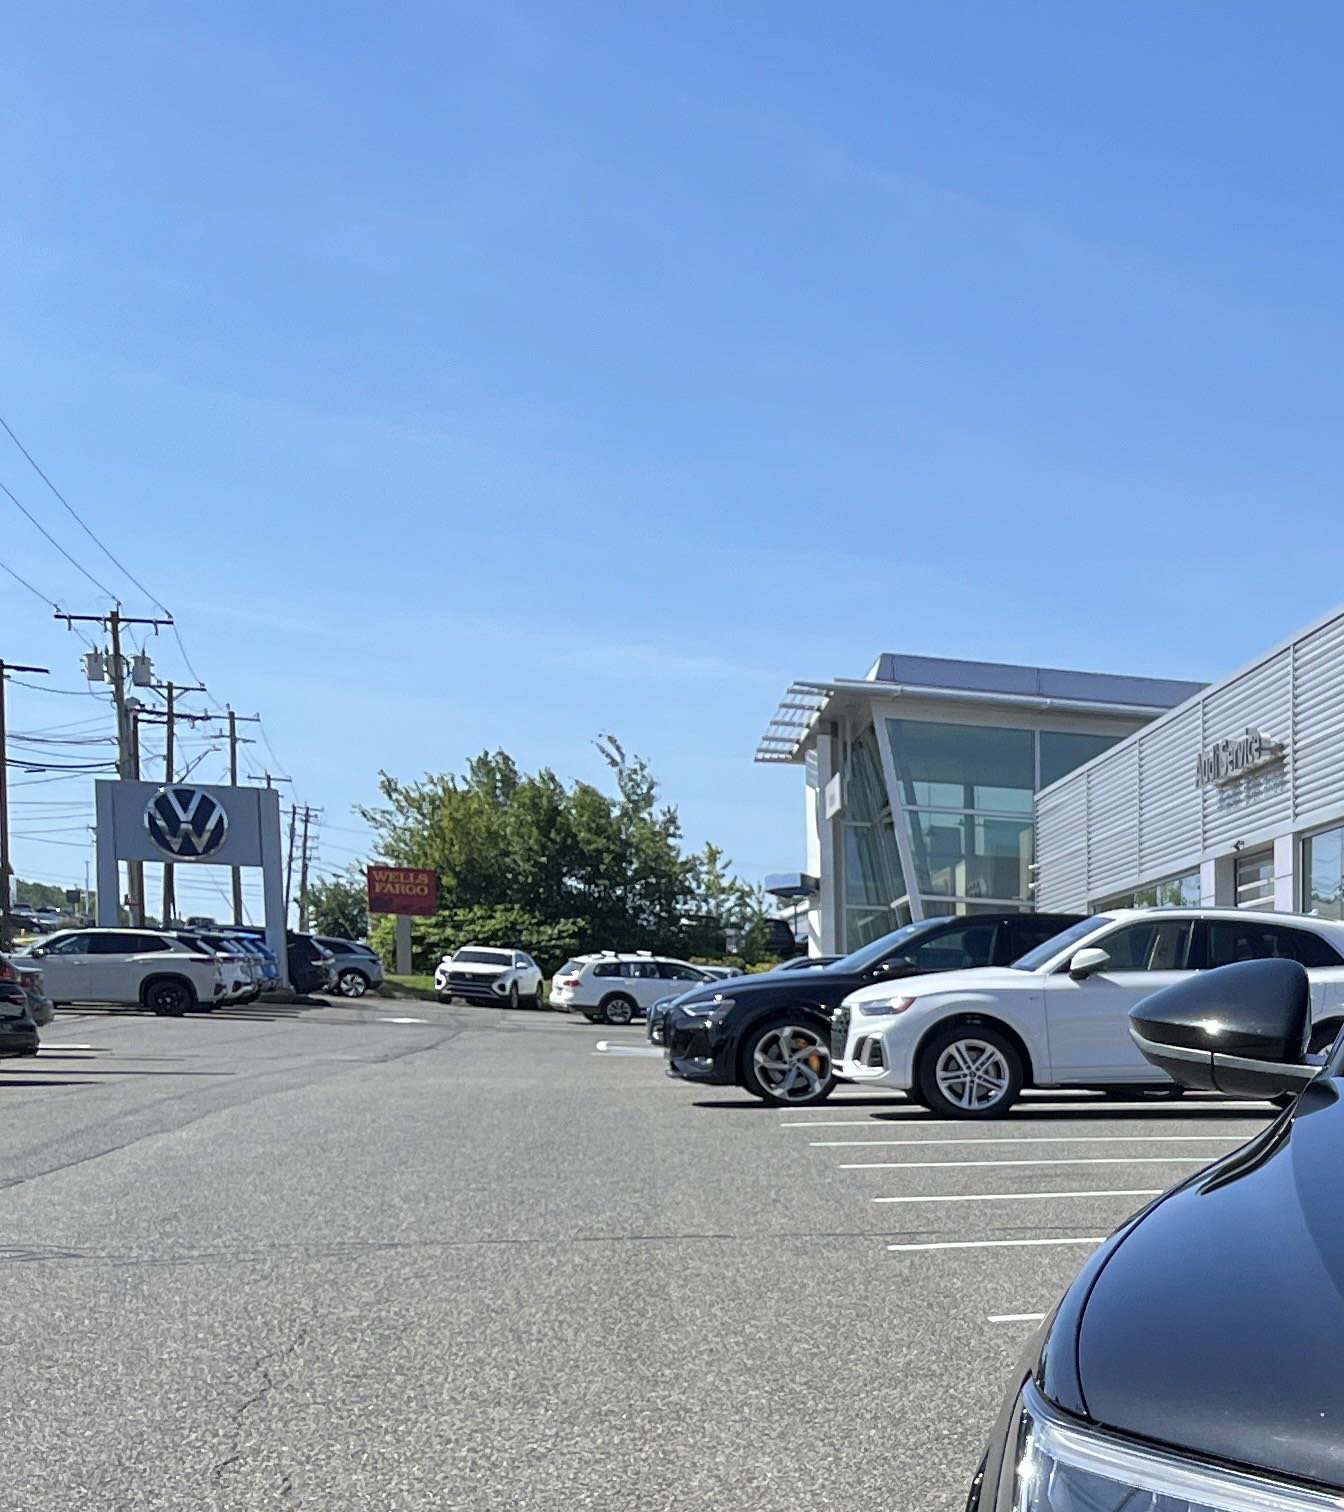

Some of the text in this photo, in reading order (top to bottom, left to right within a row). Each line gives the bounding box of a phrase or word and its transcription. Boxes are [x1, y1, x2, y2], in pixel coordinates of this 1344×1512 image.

[1195, 727, 1263, 788] Audi Service
[372, 870, 429, 885] WELLS
[374, 881, 429, 896] FARGO
